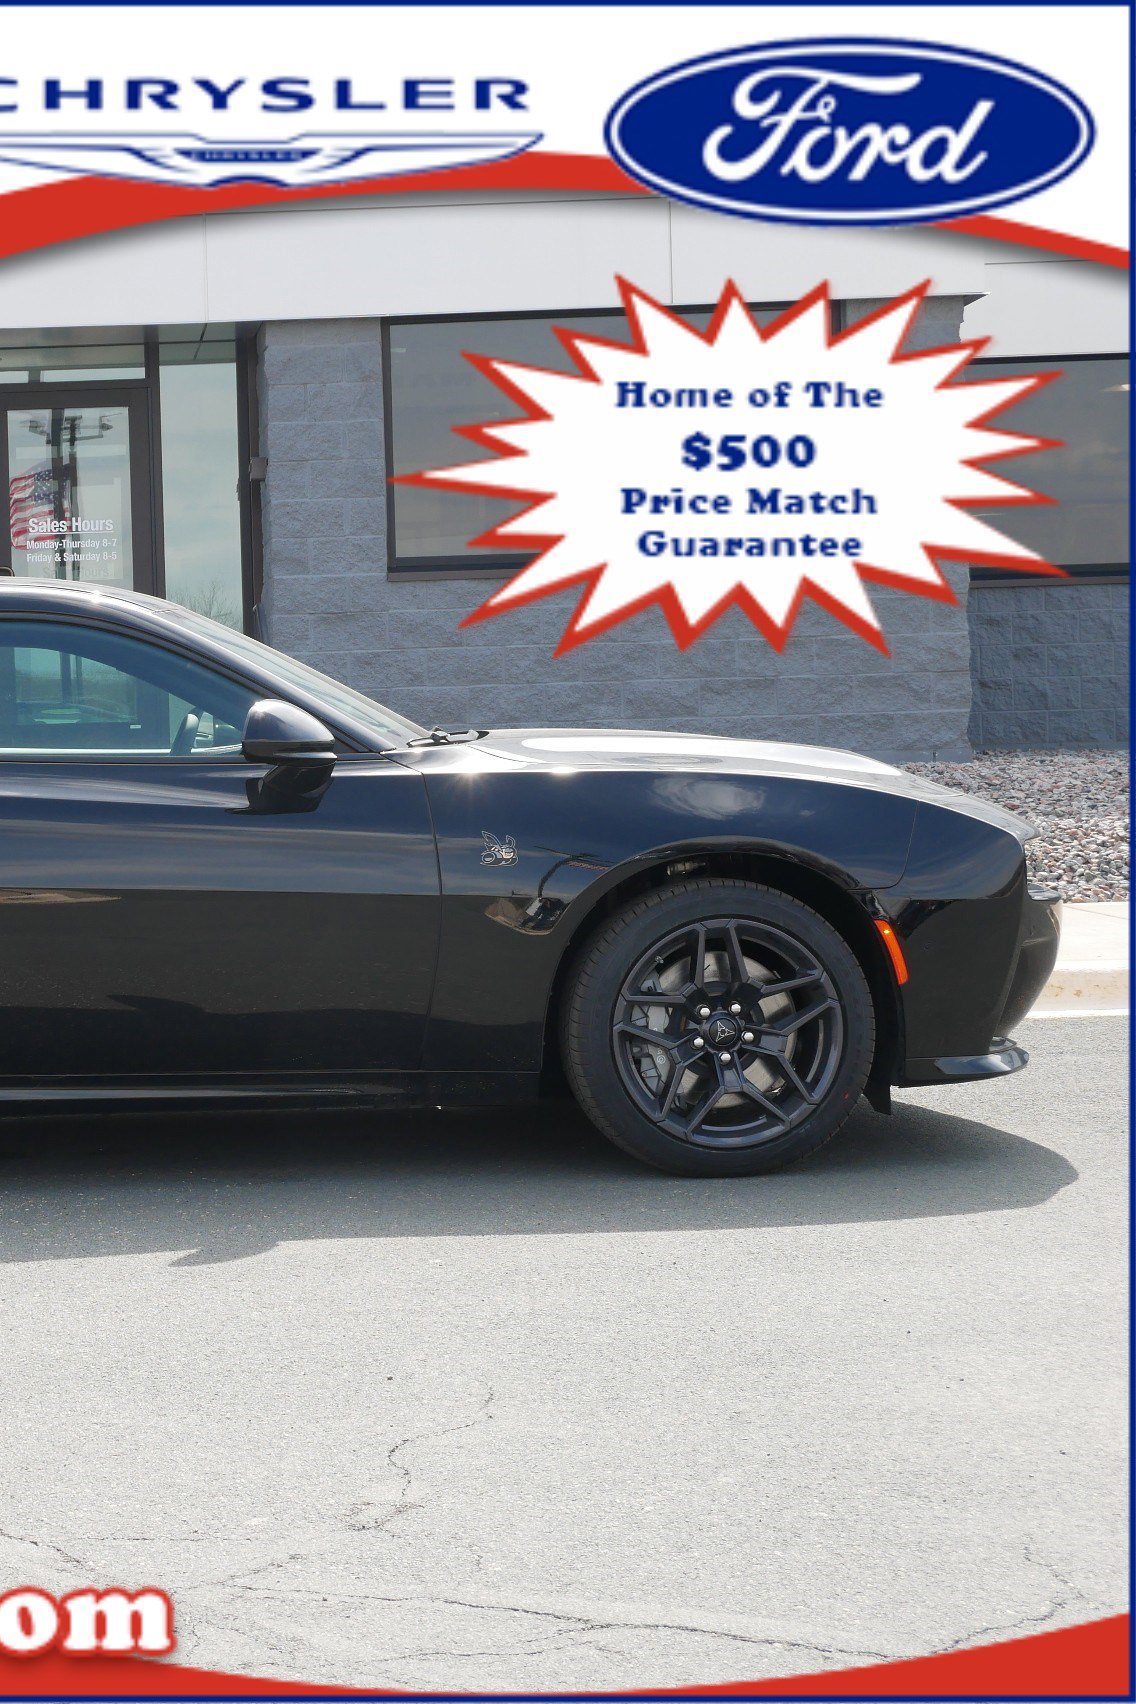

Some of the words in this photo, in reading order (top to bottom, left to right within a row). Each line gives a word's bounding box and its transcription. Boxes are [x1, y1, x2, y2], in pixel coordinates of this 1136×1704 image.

[28, 517, 67, 533] Sales
[72, 516, 114, 532] Hours
[26, 539, 100, 550] Monday-Thursday
[26, 552, 52, 563] Friday
[54, 552, 62, 562] &
[63, 551, 101, 562] Saturday
